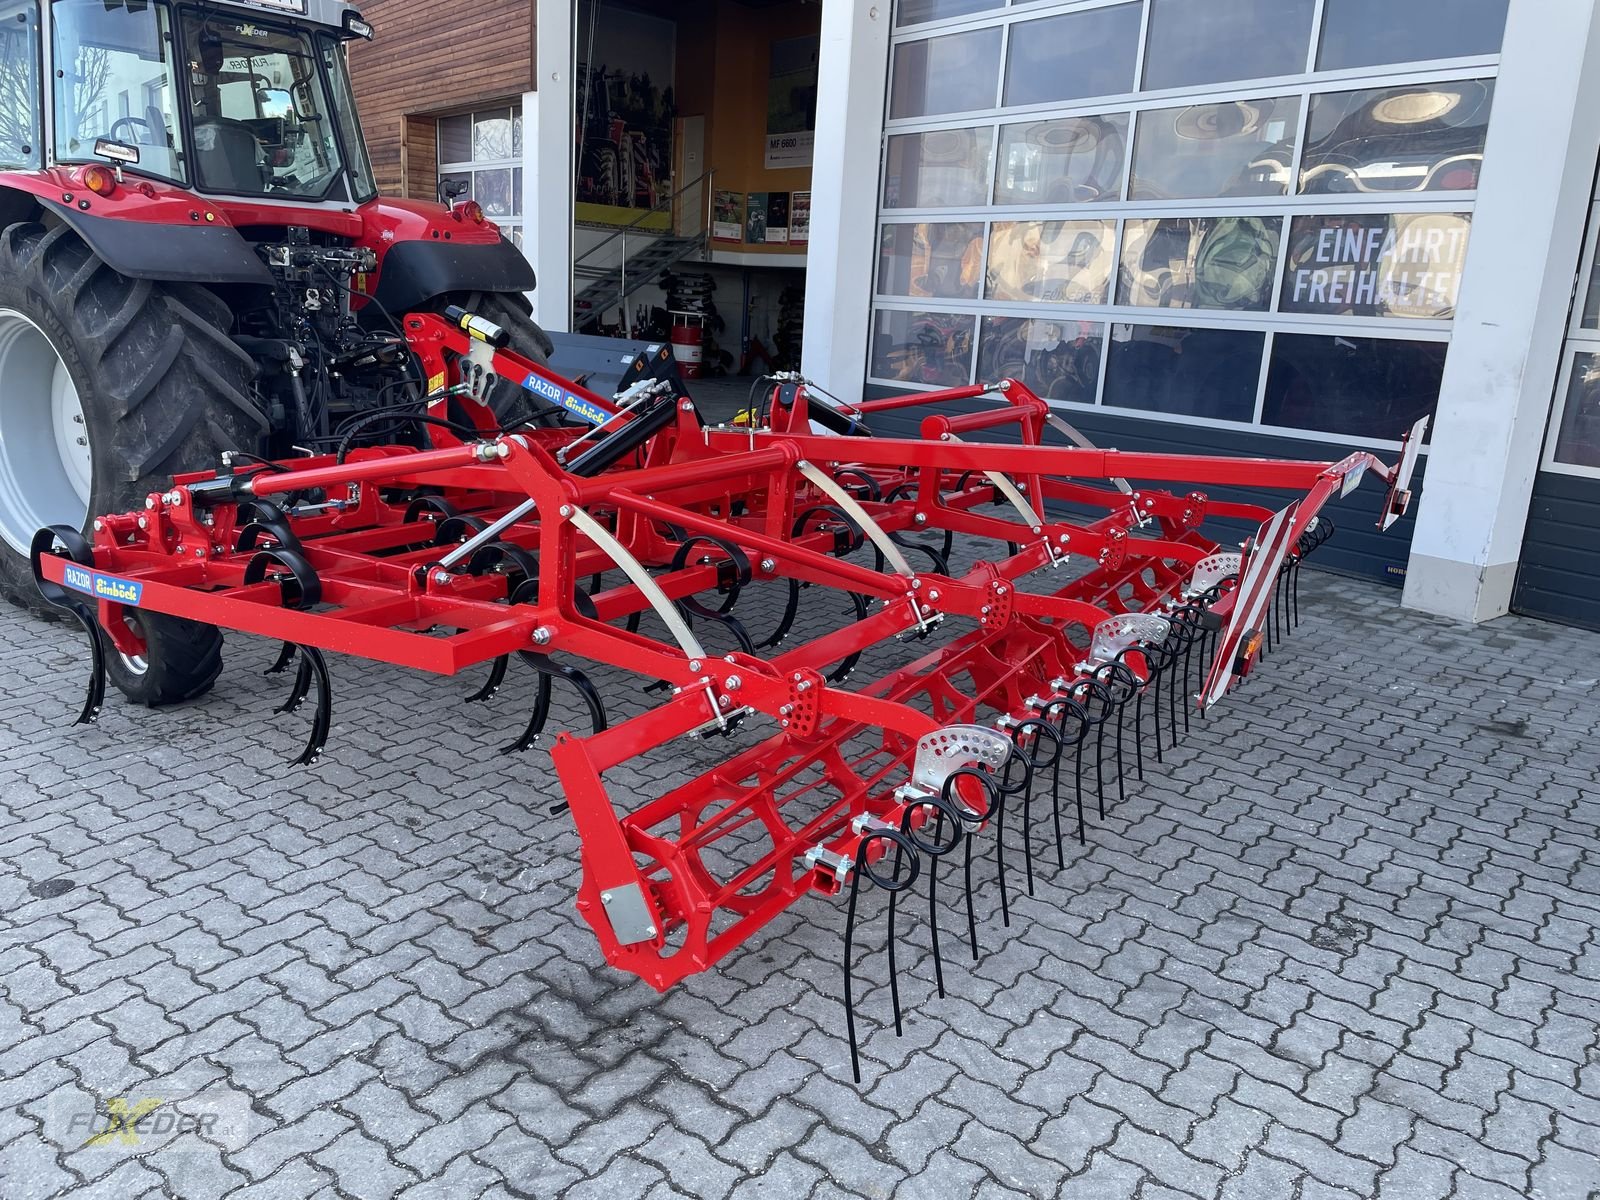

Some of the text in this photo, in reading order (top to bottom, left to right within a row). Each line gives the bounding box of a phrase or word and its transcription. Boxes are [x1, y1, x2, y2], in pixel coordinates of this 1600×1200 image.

[1316, 228, 1464, 263] EINFAHRT
[528, 375, 604, 425] RAZOR Einböck
[66, 568, 137, 601] RAZOR Einböck
